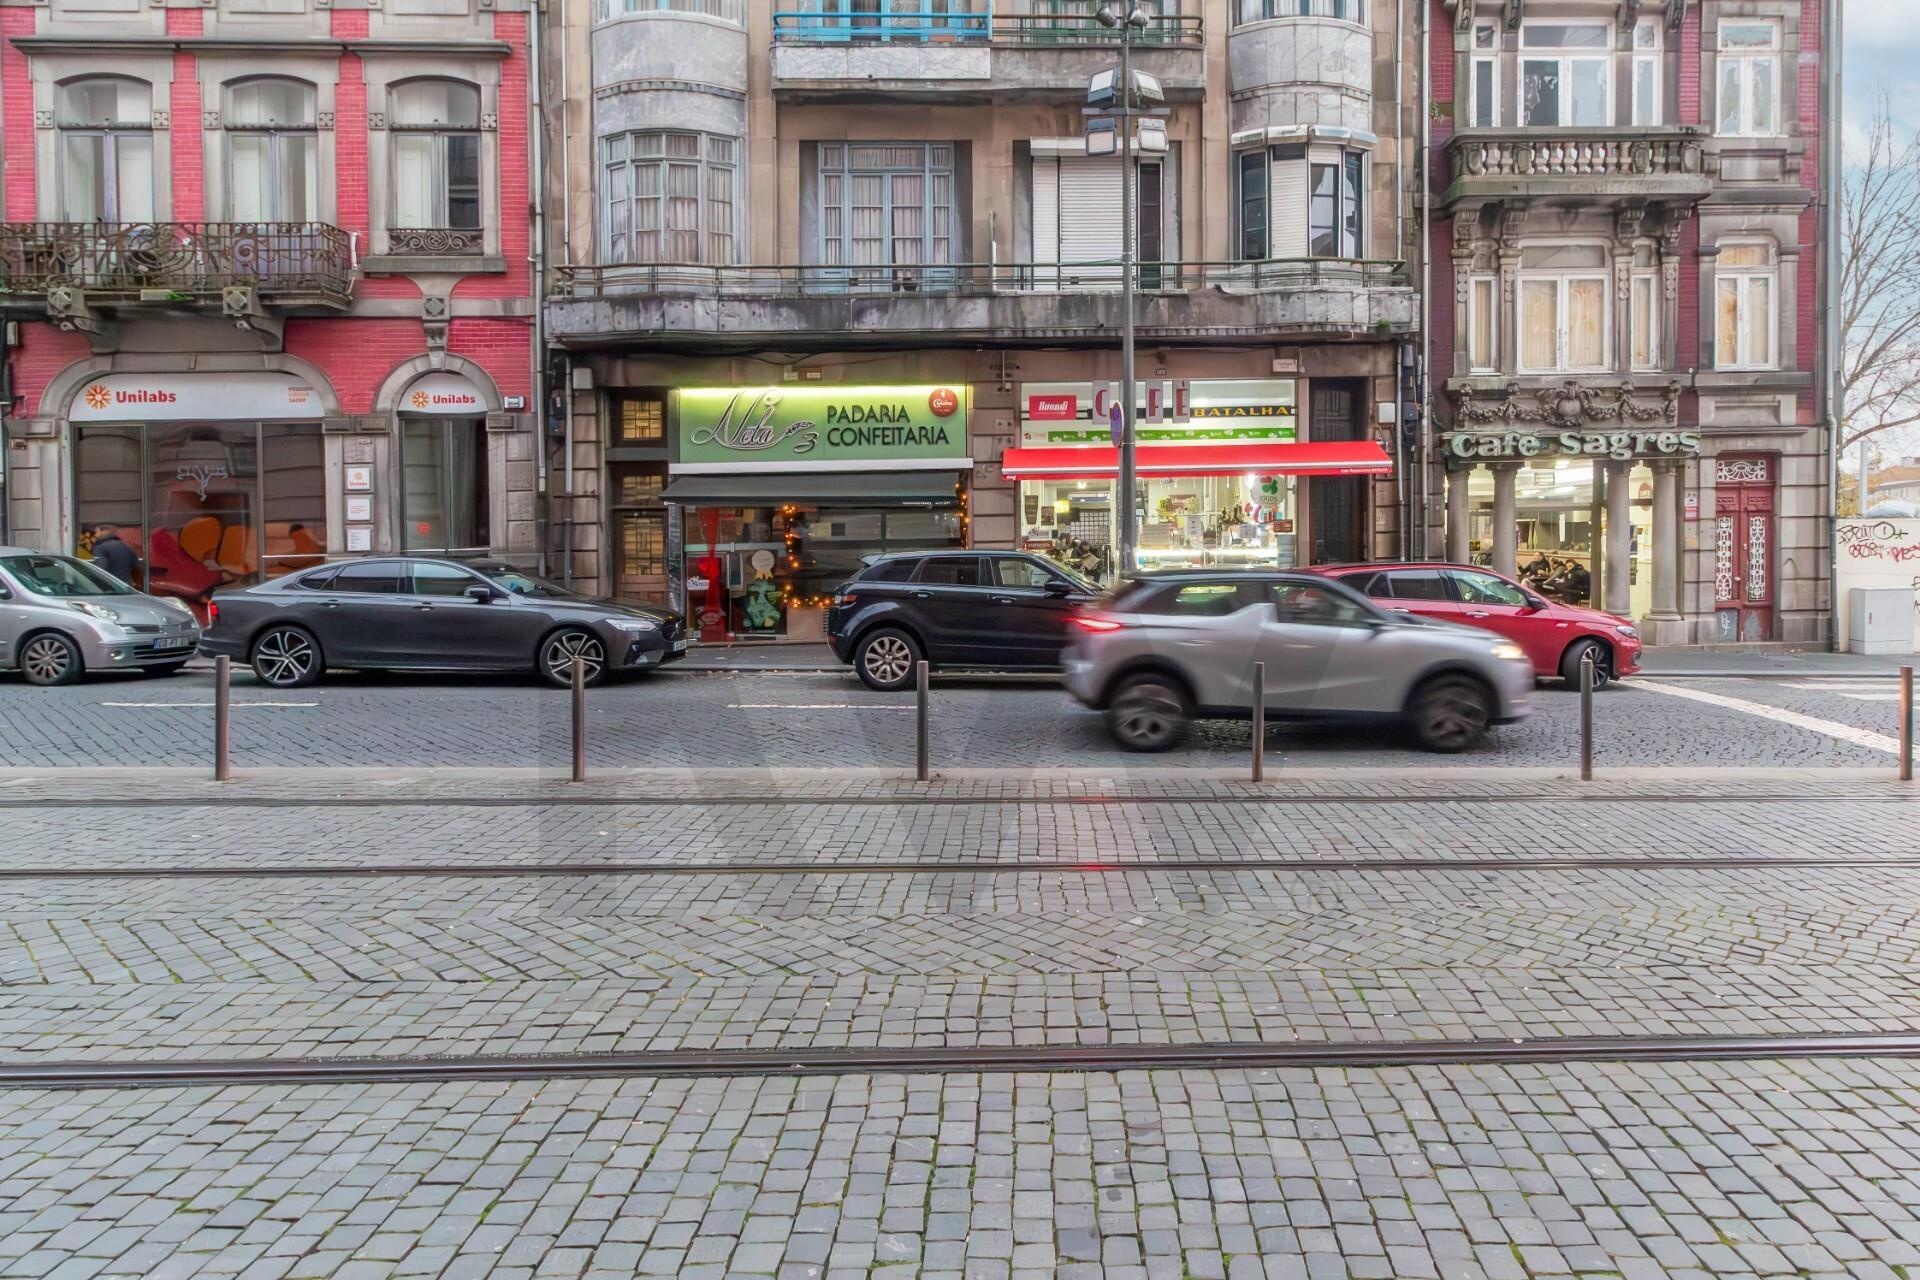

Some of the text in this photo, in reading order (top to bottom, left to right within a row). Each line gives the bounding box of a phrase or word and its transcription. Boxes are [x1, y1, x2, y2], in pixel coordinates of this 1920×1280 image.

[116, 390, 176, 404] Unilabs
[433, 394, 476, 405] Unilabs
[1095, 380, 1289, 417] CFÉ BATALHA
[827, 404, 911, 424] PADARIA
[793, 431, 819, 453] 3
[827, 426, 950, 446] CONFEITARIA
[1560, 431, 1700, 460] Sagres
